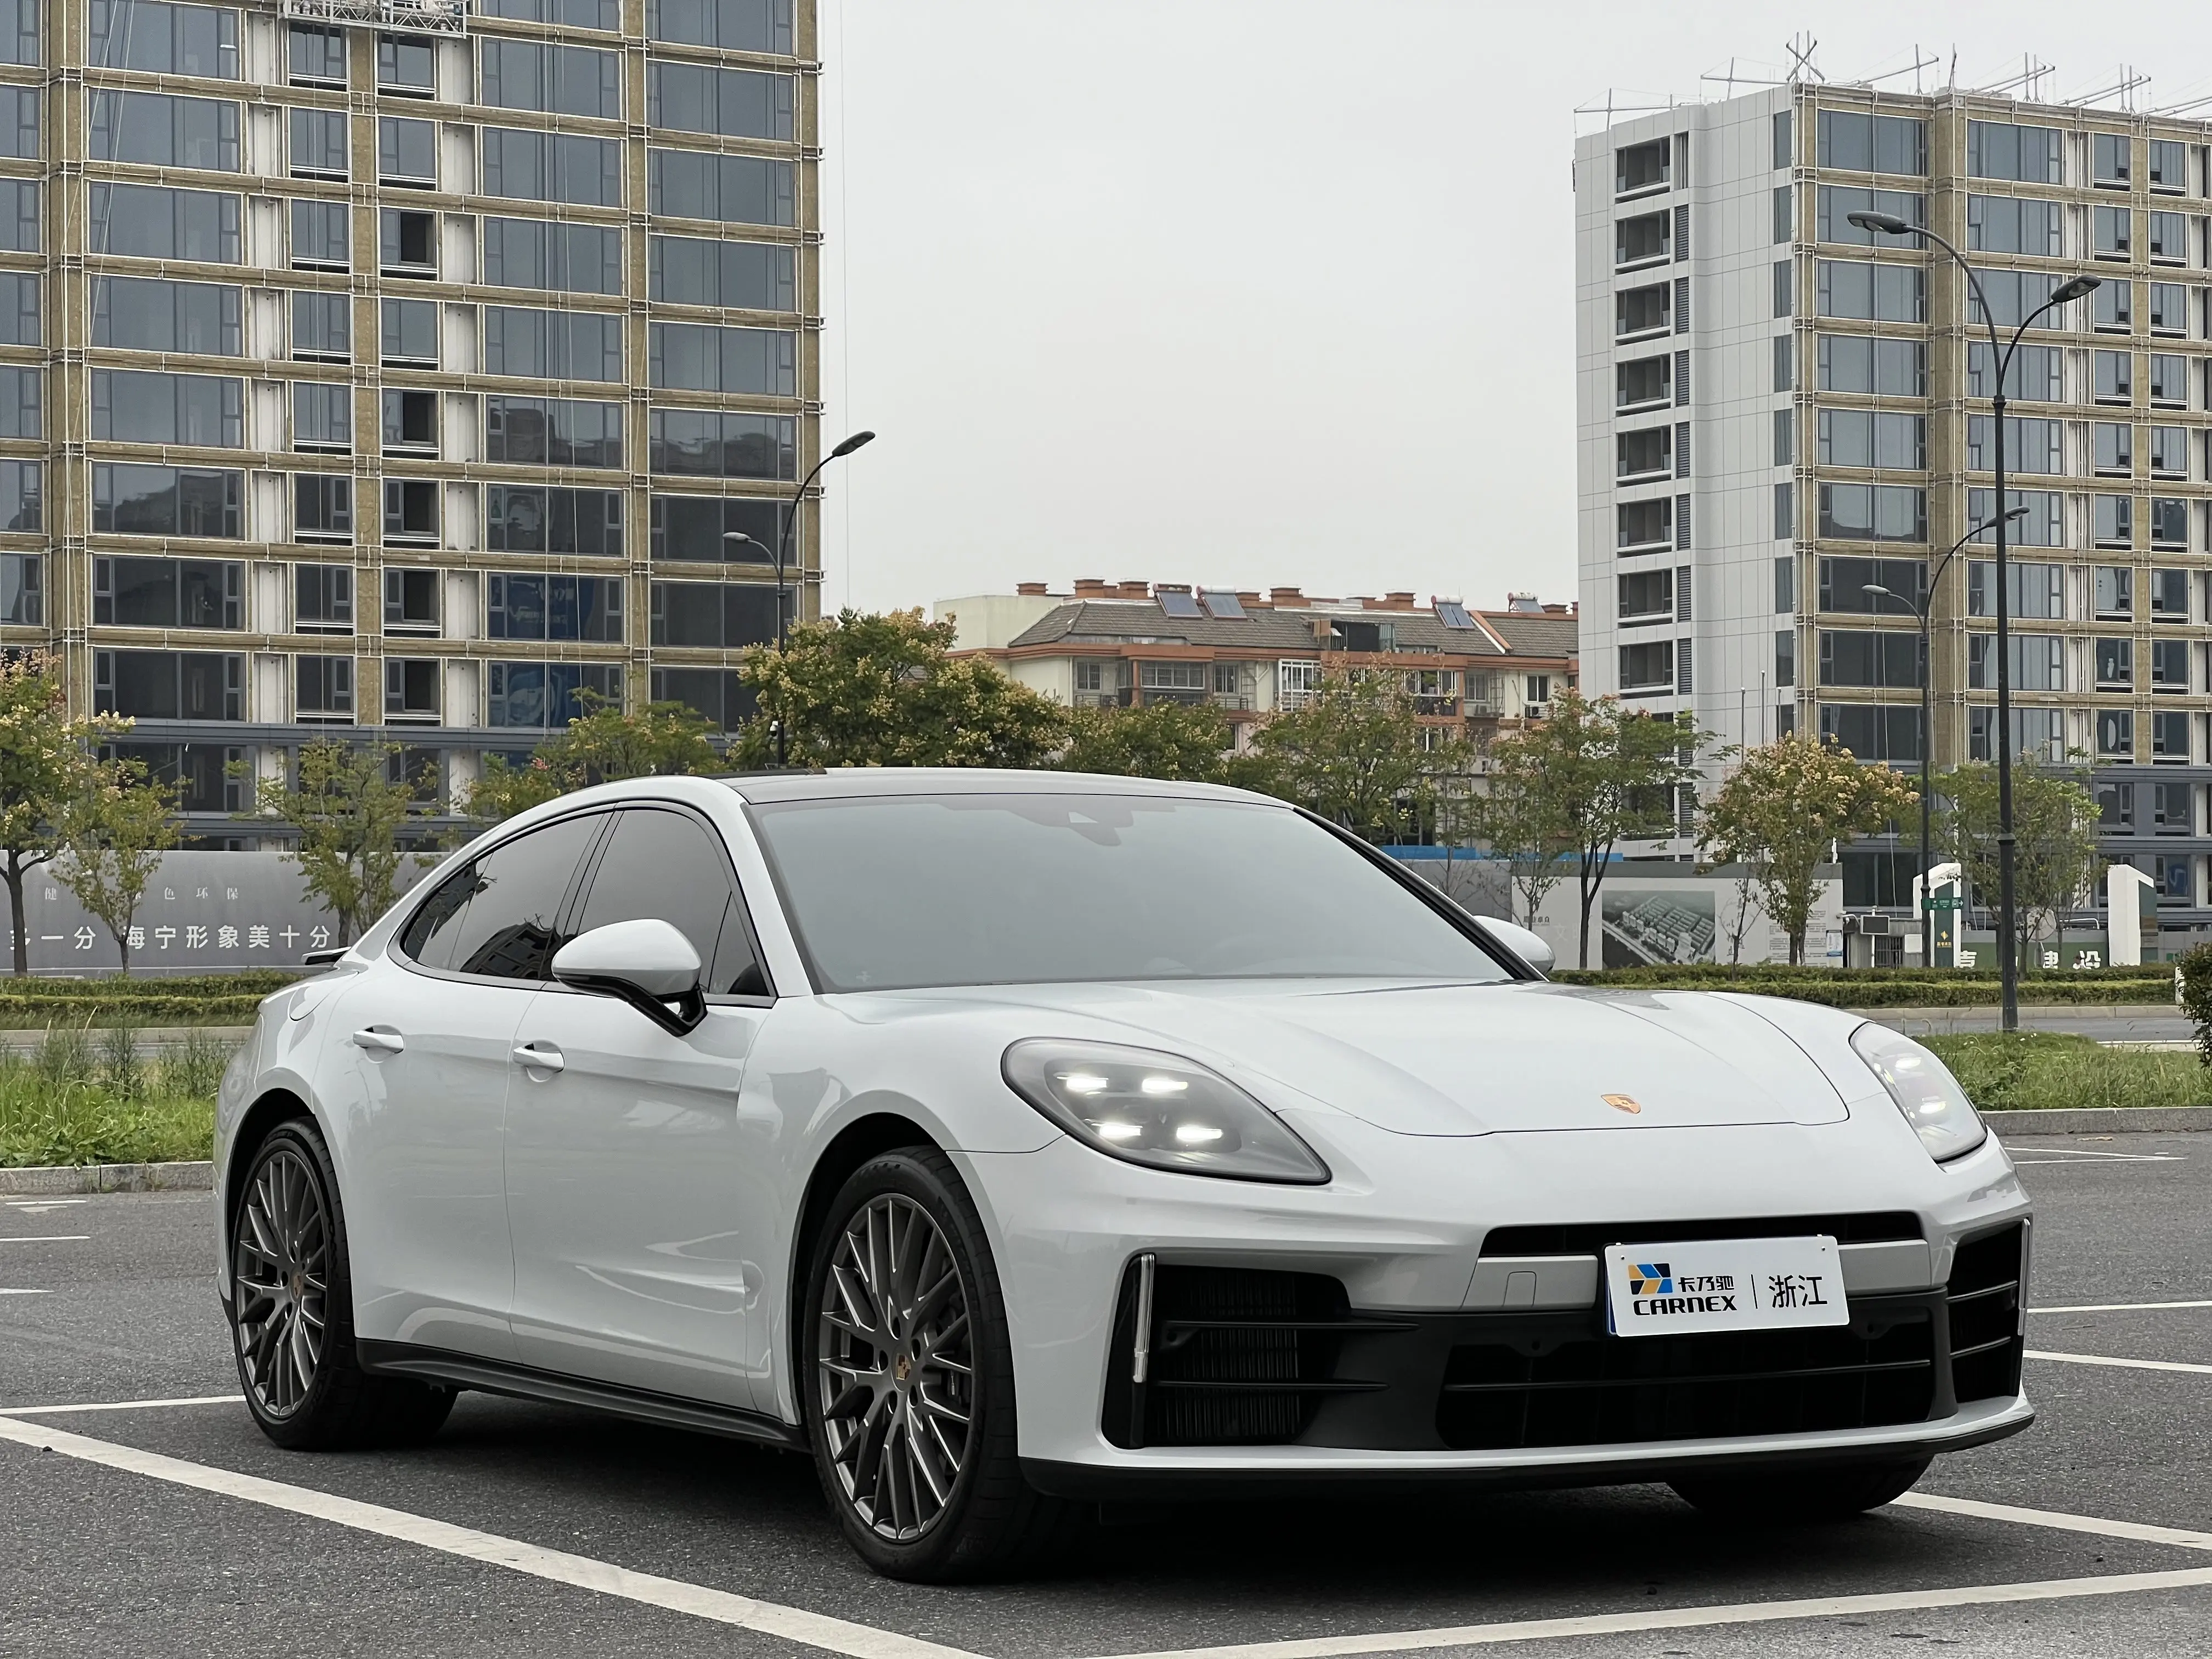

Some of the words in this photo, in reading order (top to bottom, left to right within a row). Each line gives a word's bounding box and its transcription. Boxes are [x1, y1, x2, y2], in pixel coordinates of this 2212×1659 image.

[123, 925, 331, 950] 海宁形象美十分
[1678, 1275, 1735, 1293] 卡乃驰
[1768, 1274, 1828, 1308] 浙江
[1633, 1295, 1737, 1316] CARNEX
